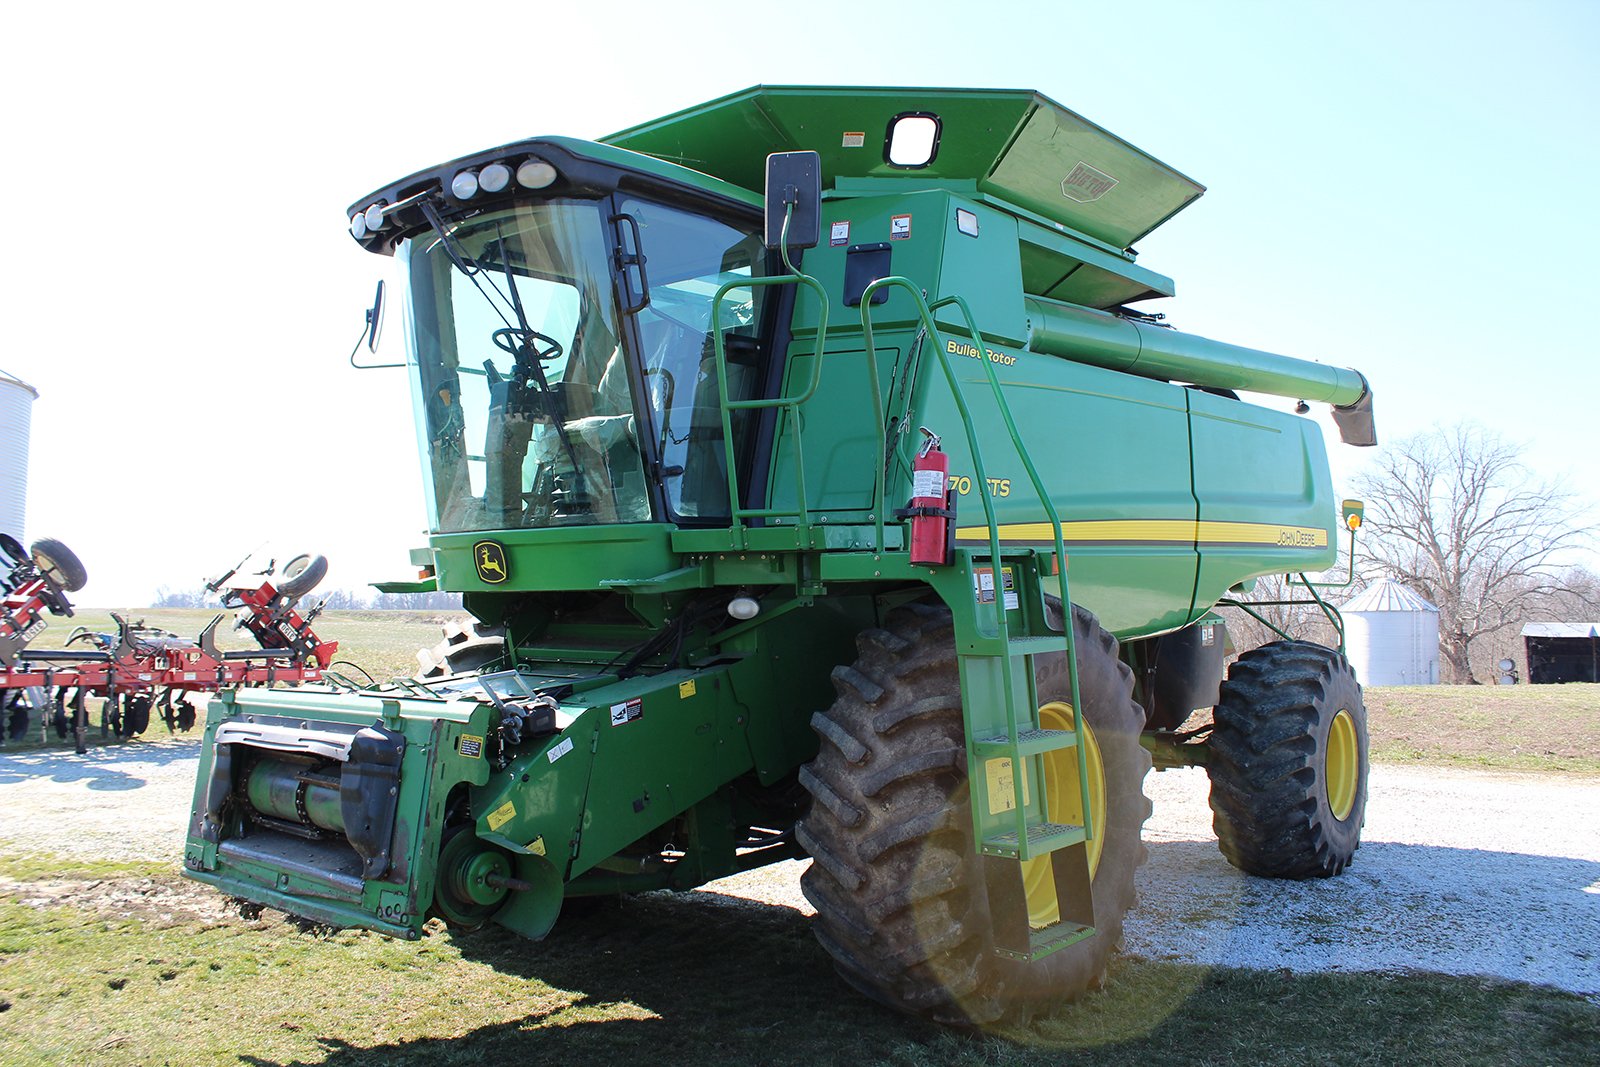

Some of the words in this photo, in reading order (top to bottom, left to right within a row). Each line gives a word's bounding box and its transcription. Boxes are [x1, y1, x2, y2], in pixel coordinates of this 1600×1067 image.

[947, 340, 982, 359] Bullet
[985, 347, 1017, 366] Rotor
[947, 475, 971, 496] 70
[1277, 529, 1296, 546] JOHN
[1295, 530, 1316, 546] DEERE
